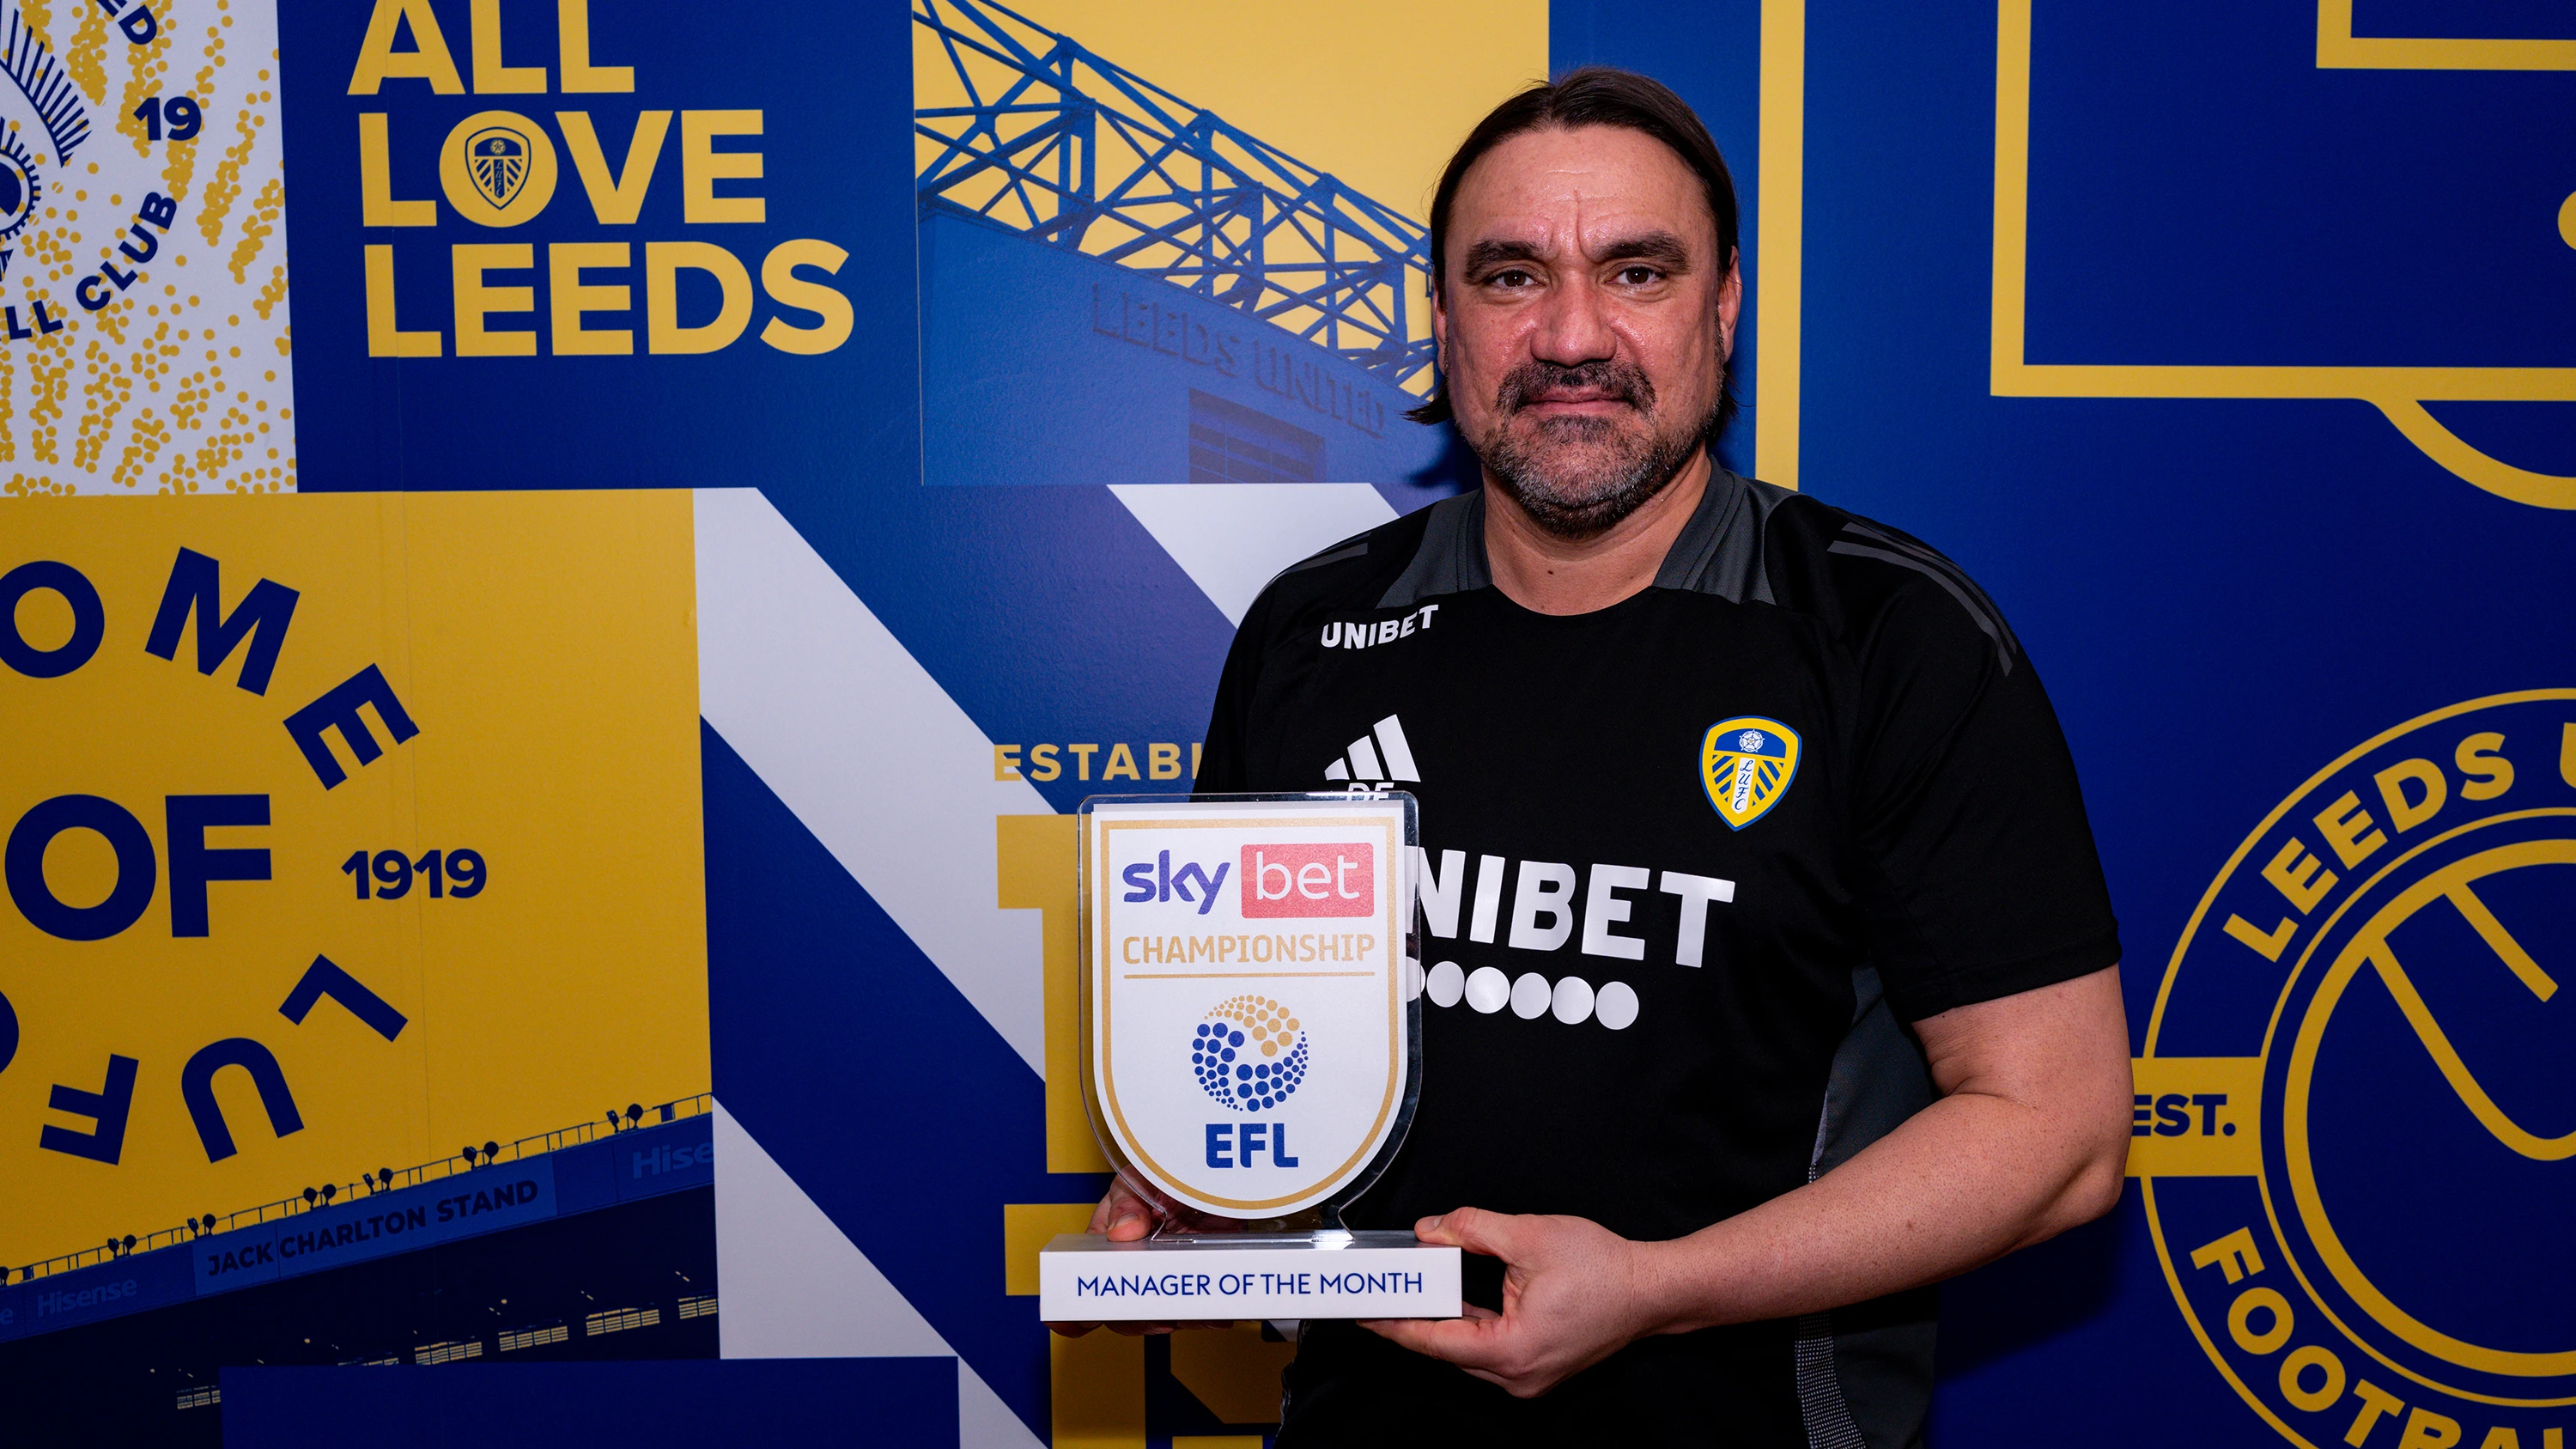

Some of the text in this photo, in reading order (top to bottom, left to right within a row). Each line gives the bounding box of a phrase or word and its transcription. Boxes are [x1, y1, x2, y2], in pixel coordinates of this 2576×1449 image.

[347, 0, 635, 95] ALL
[133, 96, 202, 141] 19
[359, 109, 766, 228] LOVE
[76, 192, 177, 311] CLUB
[0, 300, 64, 340] LL
[364, 239, 854, 357] LEEDS
[1093, 282, 1385, 440] LEEDS UNITED
[1321, 604, 1439, 649] UNIBET
[1734, 759, 1754, 811] LUFC
[5, 794, 272, 941] OF
[341, 849, 487, 900] 1919
[2222, 732, 2515, 963] LEEDS
[1123, 849, 1359, 915] sky bet
[1405, 845, 1735, 968] NIBET
[1123, 934, 1375, 965] CHAMPIONSHIP
[633, 1141, 714, 1180] Hise
[1206, 1123, 1298, 1169] EFL
[208, 1179, 539, 1276] JACK CHARLTON STAND
[36, 1276, 137, 1318] Hisense
[1078, 1272, 1422, 1297] MANAGER OF THE MONTH
